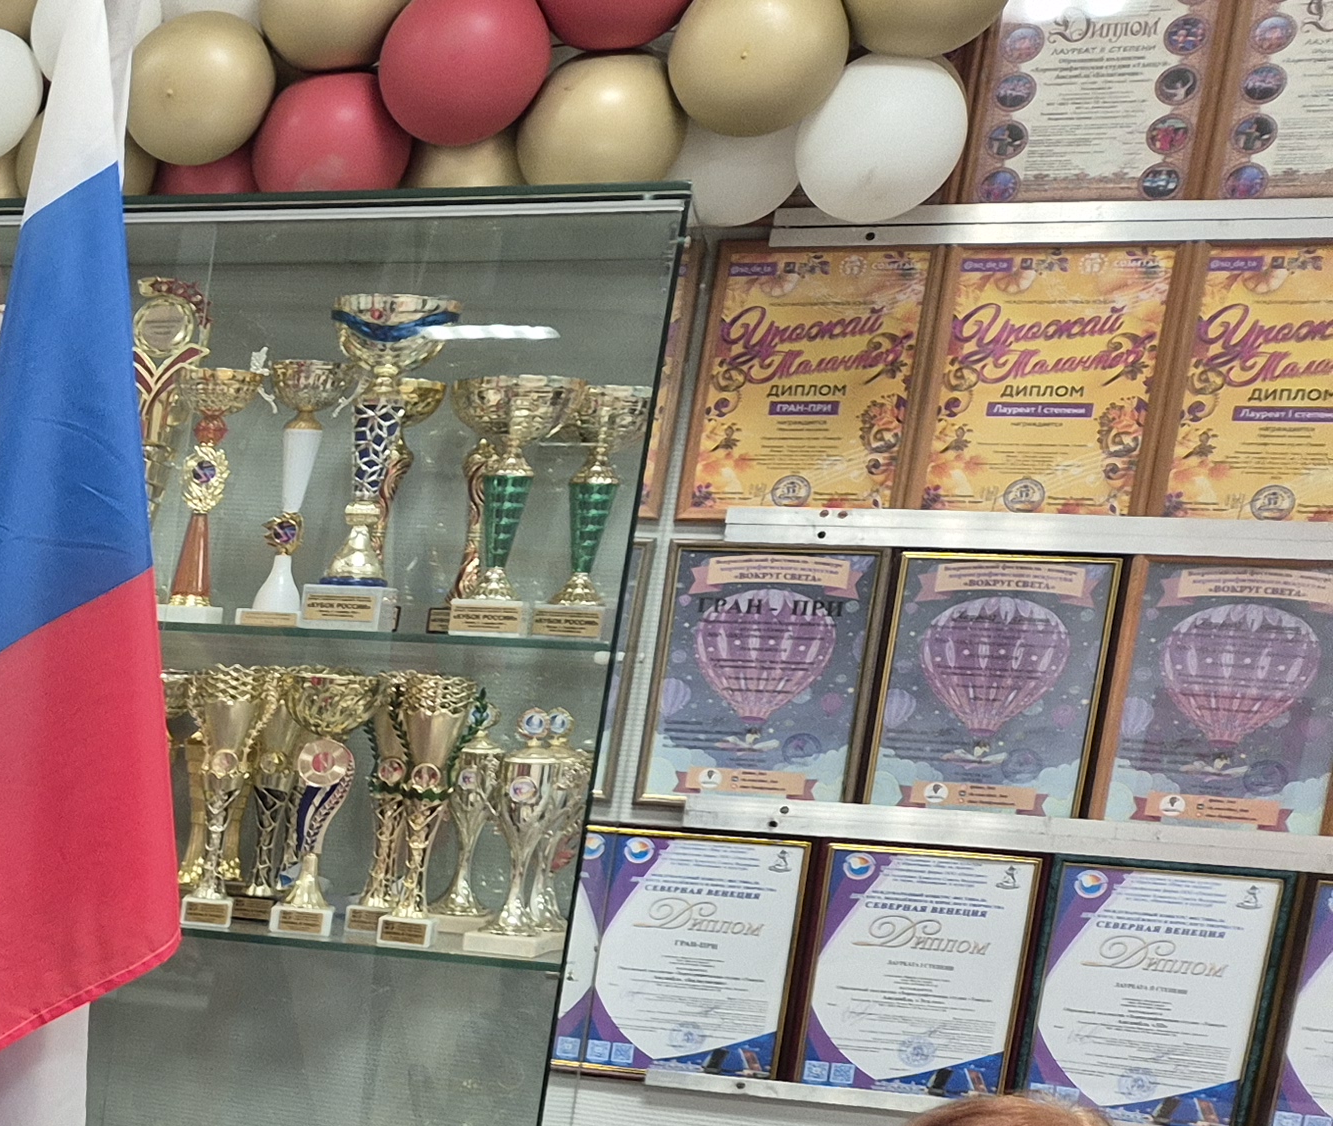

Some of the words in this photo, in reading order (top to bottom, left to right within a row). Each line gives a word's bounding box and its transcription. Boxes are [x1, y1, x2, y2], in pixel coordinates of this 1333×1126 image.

[1047, 7, 1161, 43] Диплом
[721, 305, 885, 365] Урожай
[952, 302, 1127, 365] Урожай
[747, 331, 914, 384] Талантов
[980, 332, 1157, 384] Талантов
[767, 384, 847, 398] ДИПЛОМ
[1000, 385, 1085, 398] ДИПЛОМ
[776, 403, 832, 413] ГРАН-ПРИ
[993, 404, 1036, 415] Лауреат
[1043, 406, 1086, 414] степени
[1239, 408, 1285, 419] Лауреат
[734, 572, 782, 580] «ВОКРУГ
[783, 573, 822, 583] СВЕТА»
[963, 579, 1014, 588] «ВОКРУГ
[1015, 580, 1056, 590] СВЕТА»
[1208, 584, 1260, 594] «ВОКРУГ
[1263, 586, 1307, 597] СВЕТА»
[697, 597, 762, 615] ГРАН
[792, 600, 844, 618] ПРИ
[645, 884, 703, 895] СЕВЕРНАЯ
[706, 888, 761, 900] ВЕНЕЦИЯ
[633, 897, 765, 937] Диплом
[865, 901, 928, 913] СЕВЕРНАЯ
[930, 906, 988, 918] ВЕНЕЦИЯ
[851, 915, 991, 956] Диплом
[1096, 920, 1161, 933] СЕВЕРНАЯ
[1164, 926, 1226, 939] ВЕНЕЦИЯ
[1081, 935, 1229, 978] Диплом
